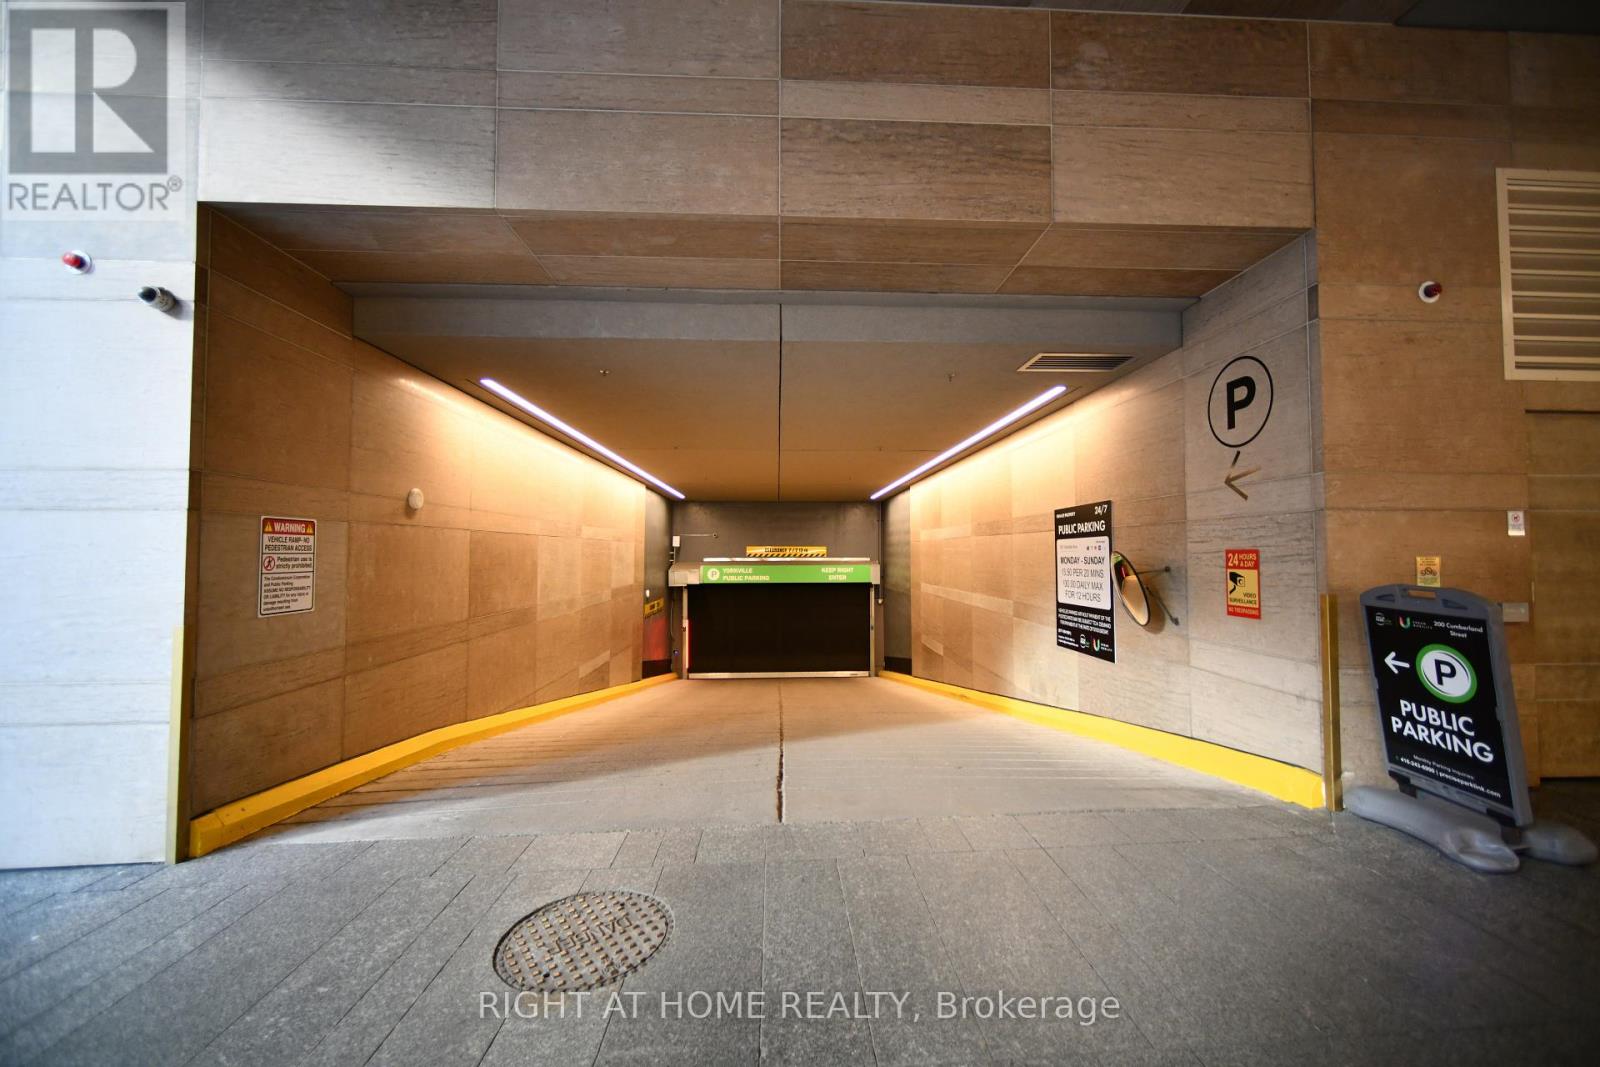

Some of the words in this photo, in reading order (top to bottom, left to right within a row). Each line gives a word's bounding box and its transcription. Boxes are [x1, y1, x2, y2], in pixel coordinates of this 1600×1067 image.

[1226, 375, 1256, 430] P
[1094, 504, 1108, 516] 24/7
[273, 521, 306, 533] WARNING
[1058, 523, 1077, 536] PUBLIC
[1077, 520, 1106, 534] PARKING
[1060, 556, 1080, 565] MONDAY
[1083, 556, 1105, 565] SUNDAY
[1228, 553, 1239, 567] 24
[1239, 553, 1257, 561] HOURS
[1244, 560, 1255, 568] DAY
[1446, 622, 1484, 634] Cumberland
[1449, 630, 1468, 639] Street
[1434, 659, 1457, 686] P
[1400, 699, 1475, 736] PUBLIC
[1391, 716, 1494, 763] PARKING
